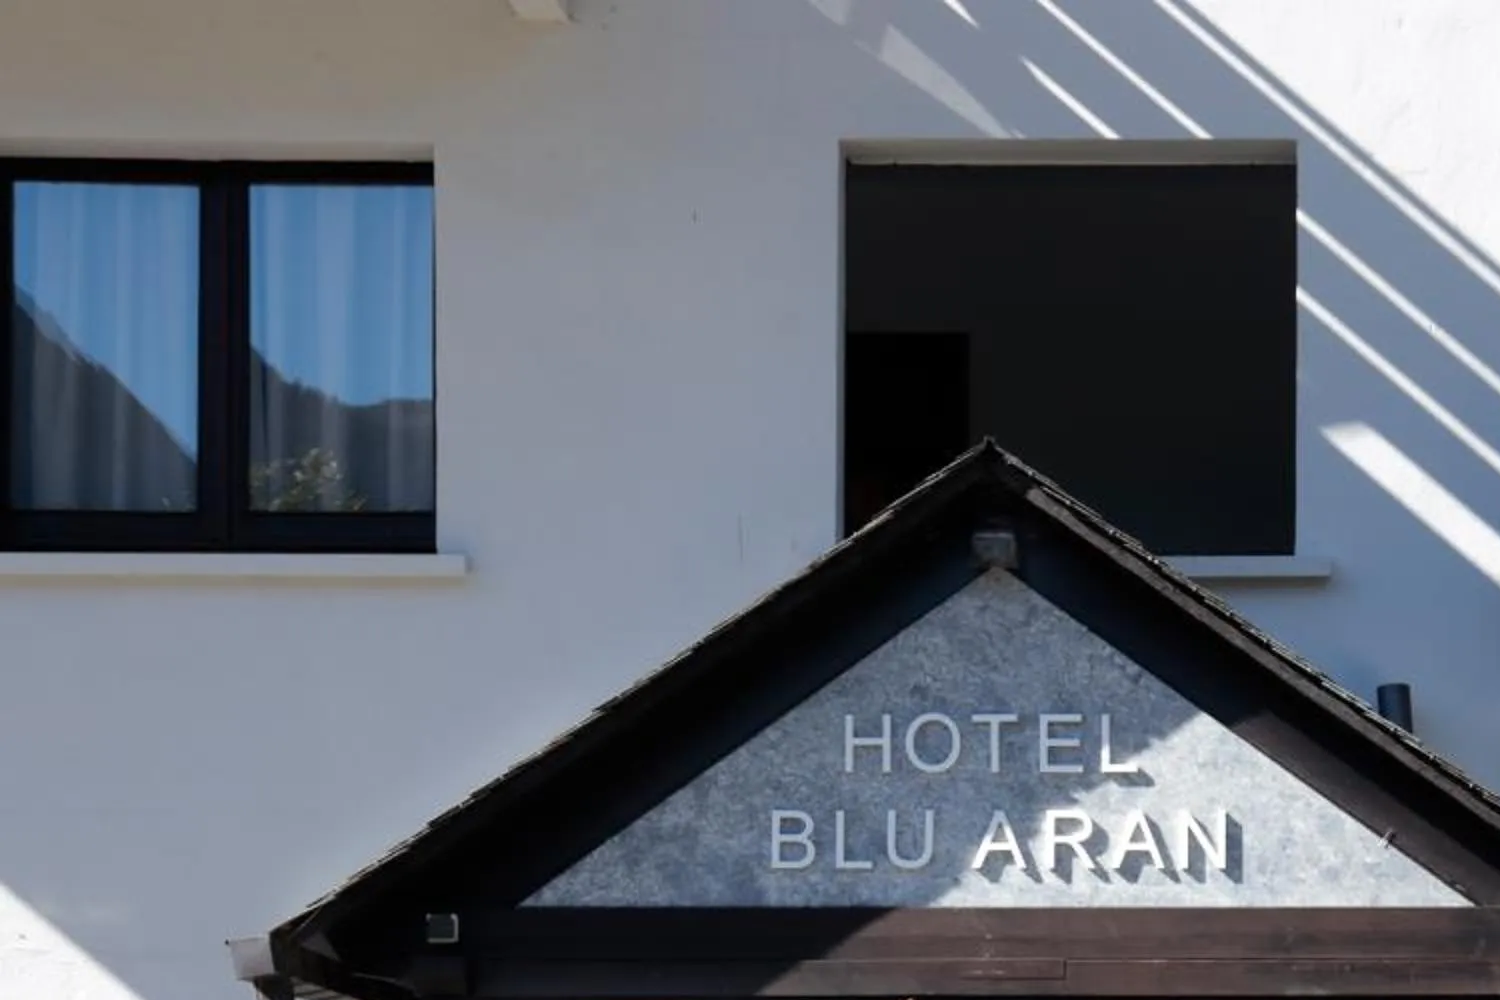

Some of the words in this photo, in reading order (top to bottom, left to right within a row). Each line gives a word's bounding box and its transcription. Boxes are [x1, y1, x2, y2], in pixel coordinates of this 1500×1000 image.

[842, 713, 1139, 775] HOTEL
[769, 809, 935, 871] BLU
[970, 808, 1229, 871] ARAN
